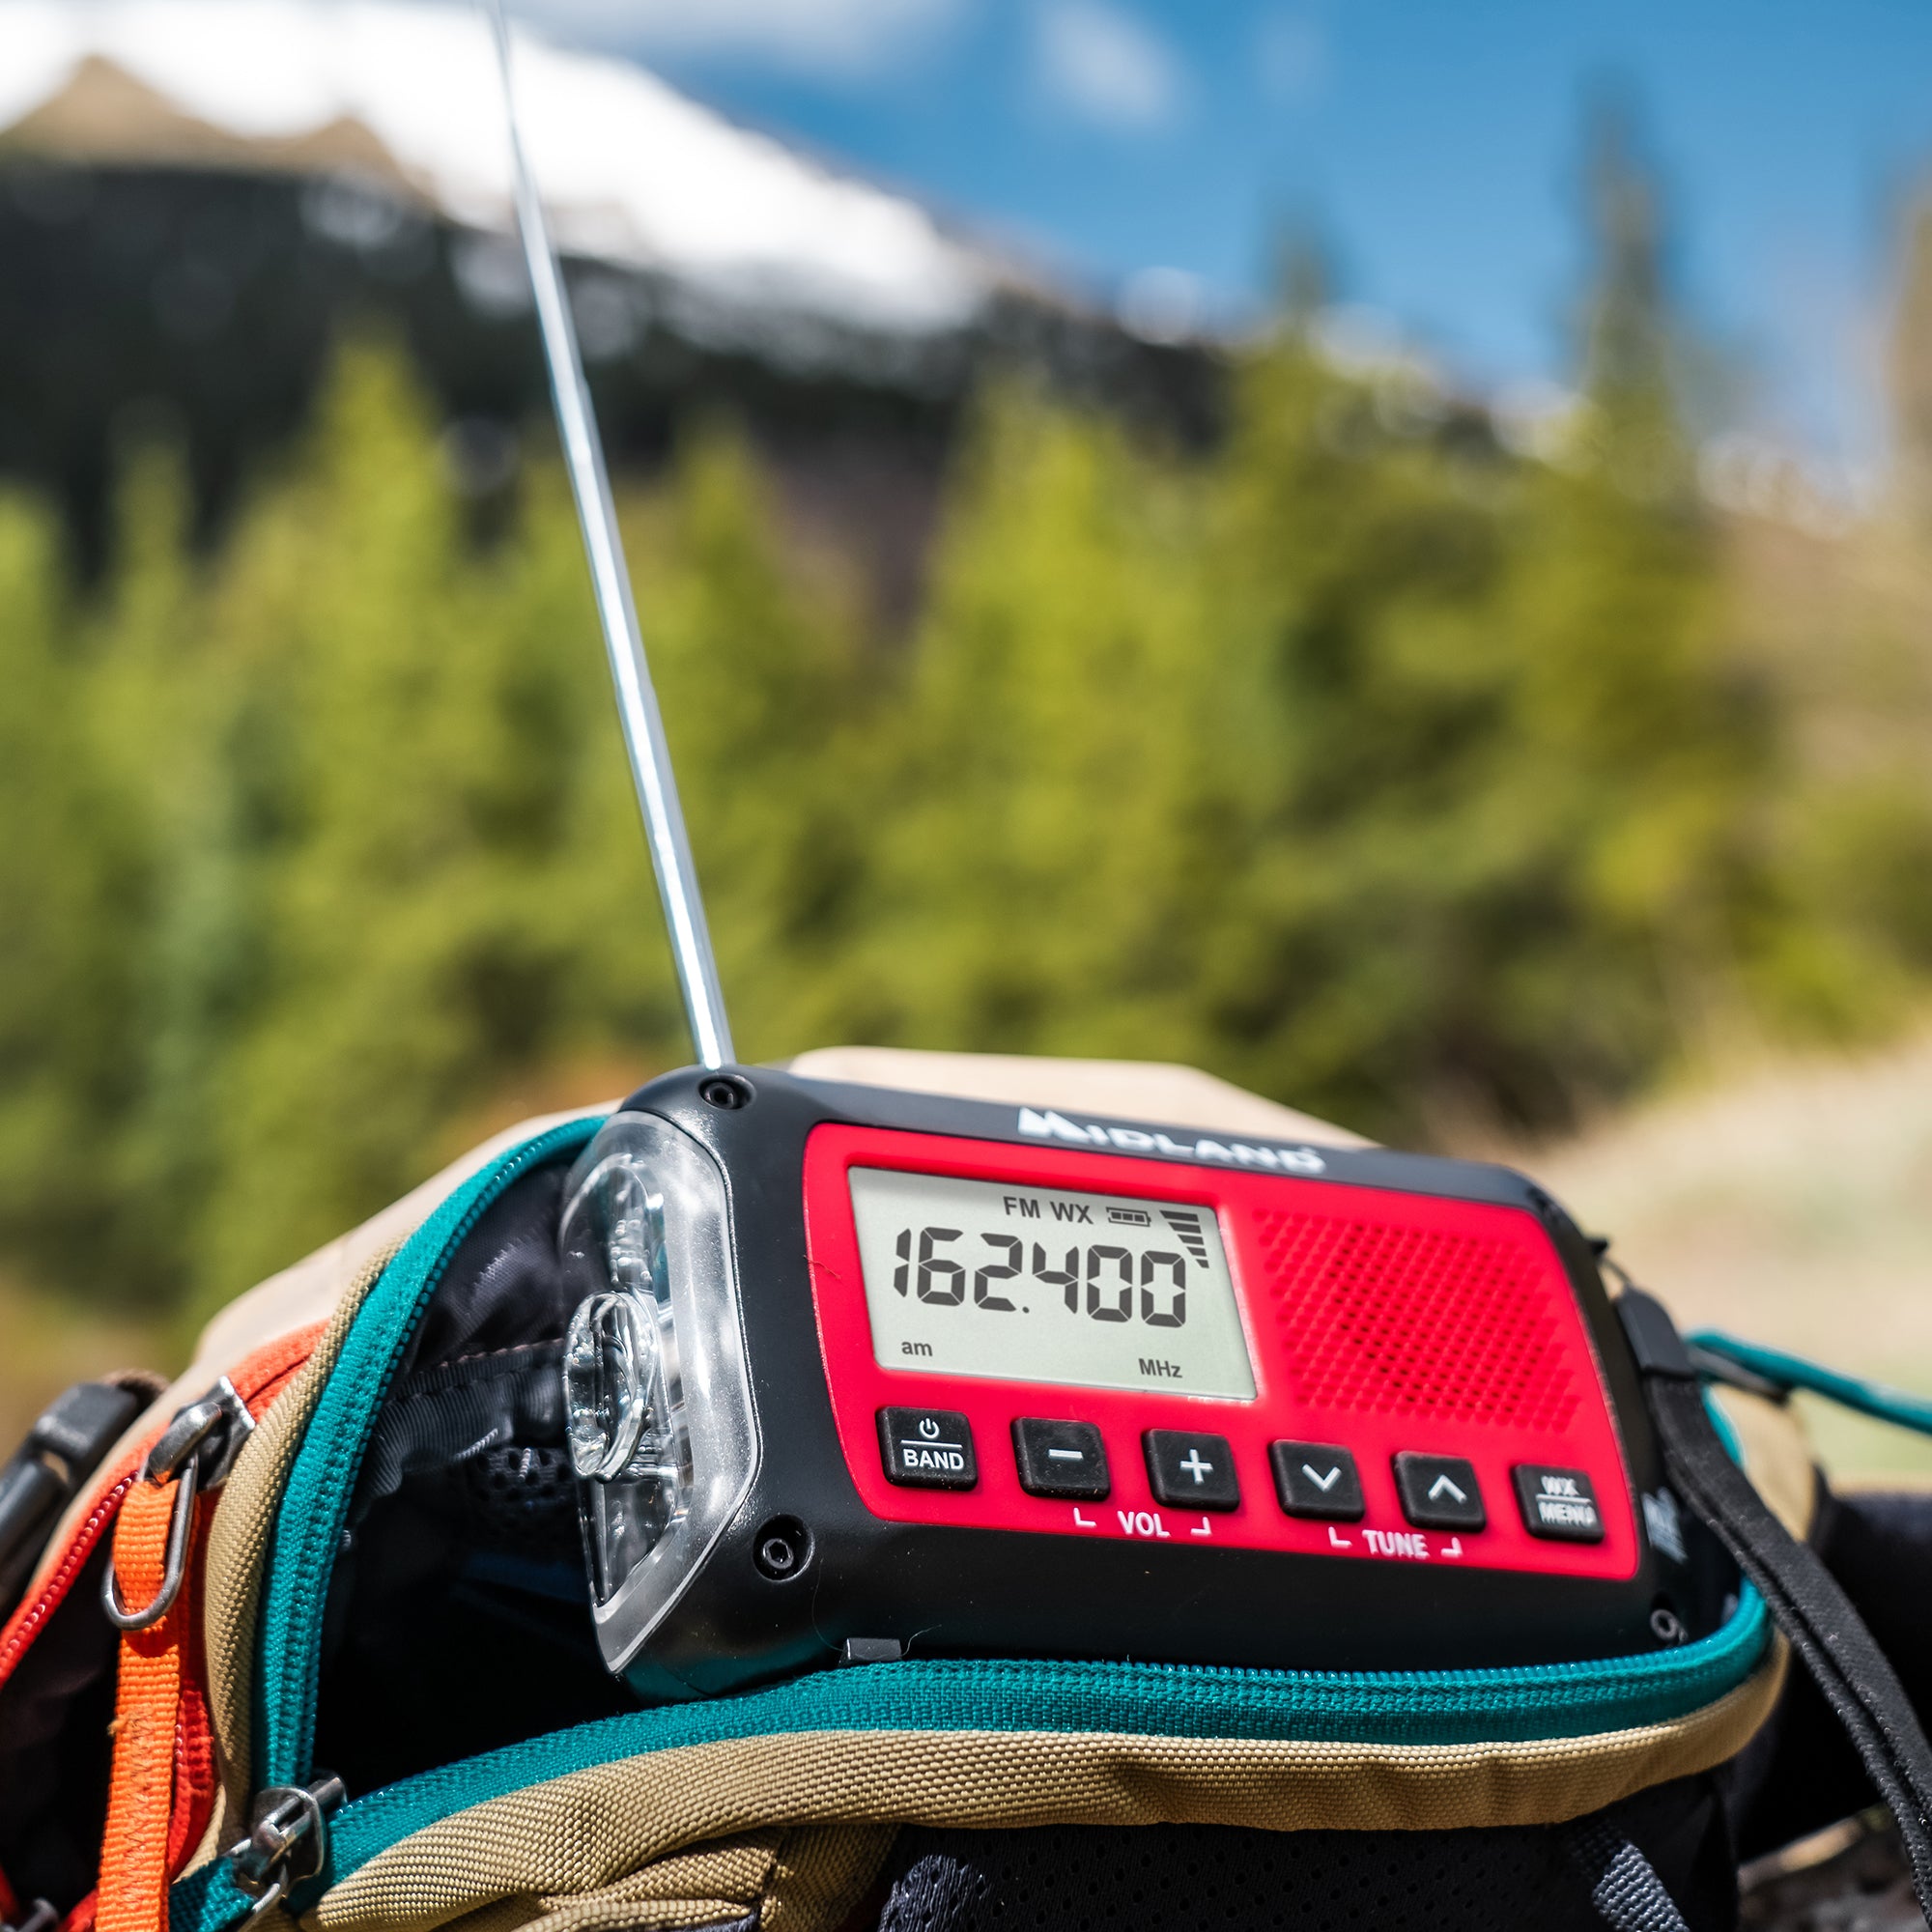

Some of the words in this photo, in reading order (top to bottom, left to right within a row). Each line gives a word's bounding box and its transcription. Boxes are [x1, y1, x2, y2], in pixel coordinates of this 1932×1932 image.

[1003, 1196, 1041, 1219] FM
[1050, 1201, 1094, 1225] WX
[894, 1226, 1186, 1328] 162.400
[901, 1341, 933, 1357] am
[1139, 1358, 1183, 1379] MHz
[902, 1448, 964, 1471] BAND
[1117, 1510, 1171, 1537] VOL
[1538, 1501, 1597, 1527] MENU
[1362, 1529, 1431, 1559] TUNE
